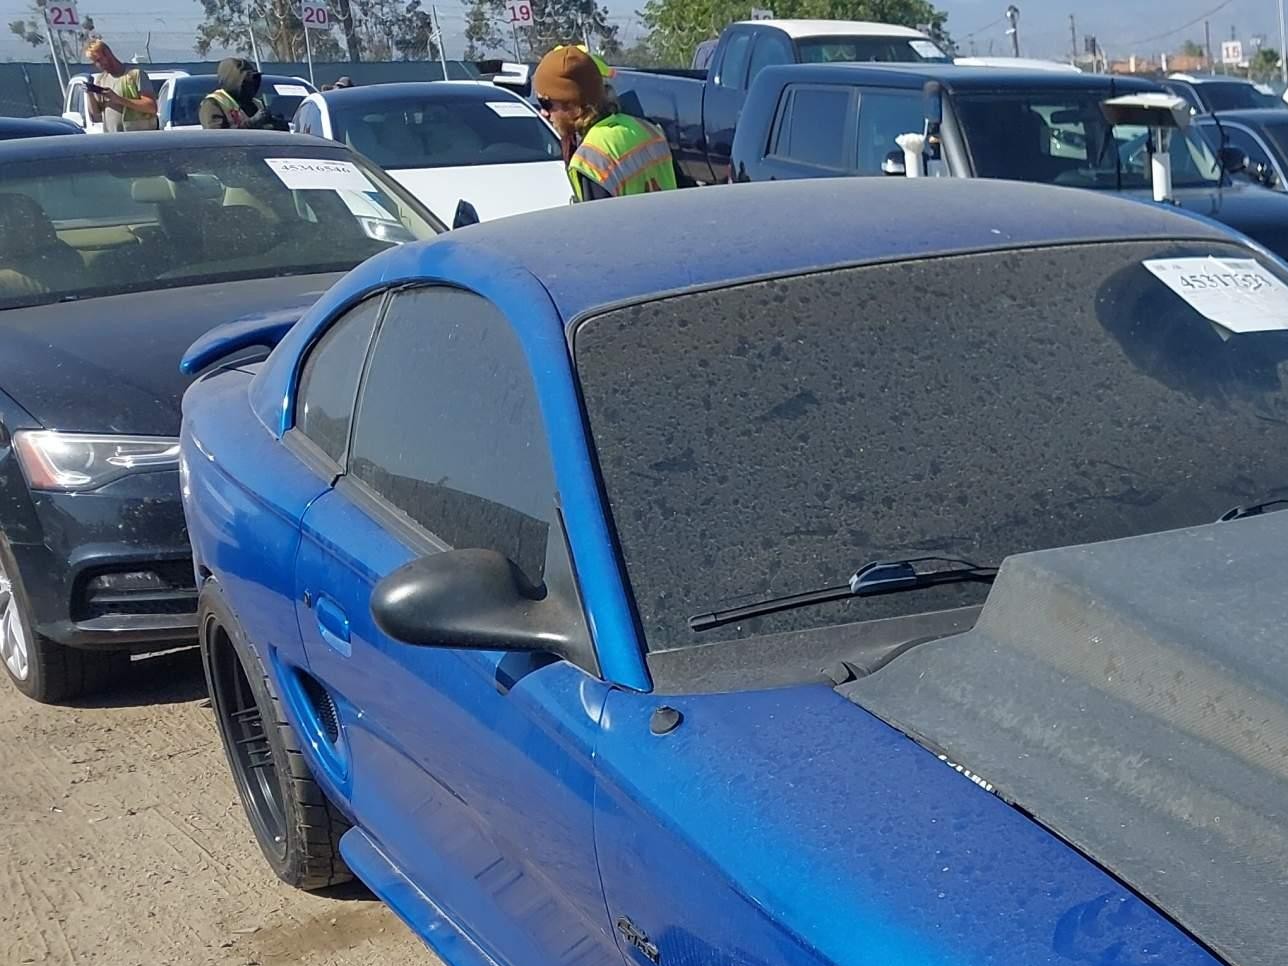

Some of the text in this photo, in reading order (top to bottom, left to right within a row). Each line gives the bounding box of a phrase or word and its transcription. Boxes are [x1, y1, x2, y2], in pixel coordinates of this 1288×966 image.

[50, 7, 79, 25] 21
[304, 7, 327, 24] 20
[509, 5, 531, 21] 19
